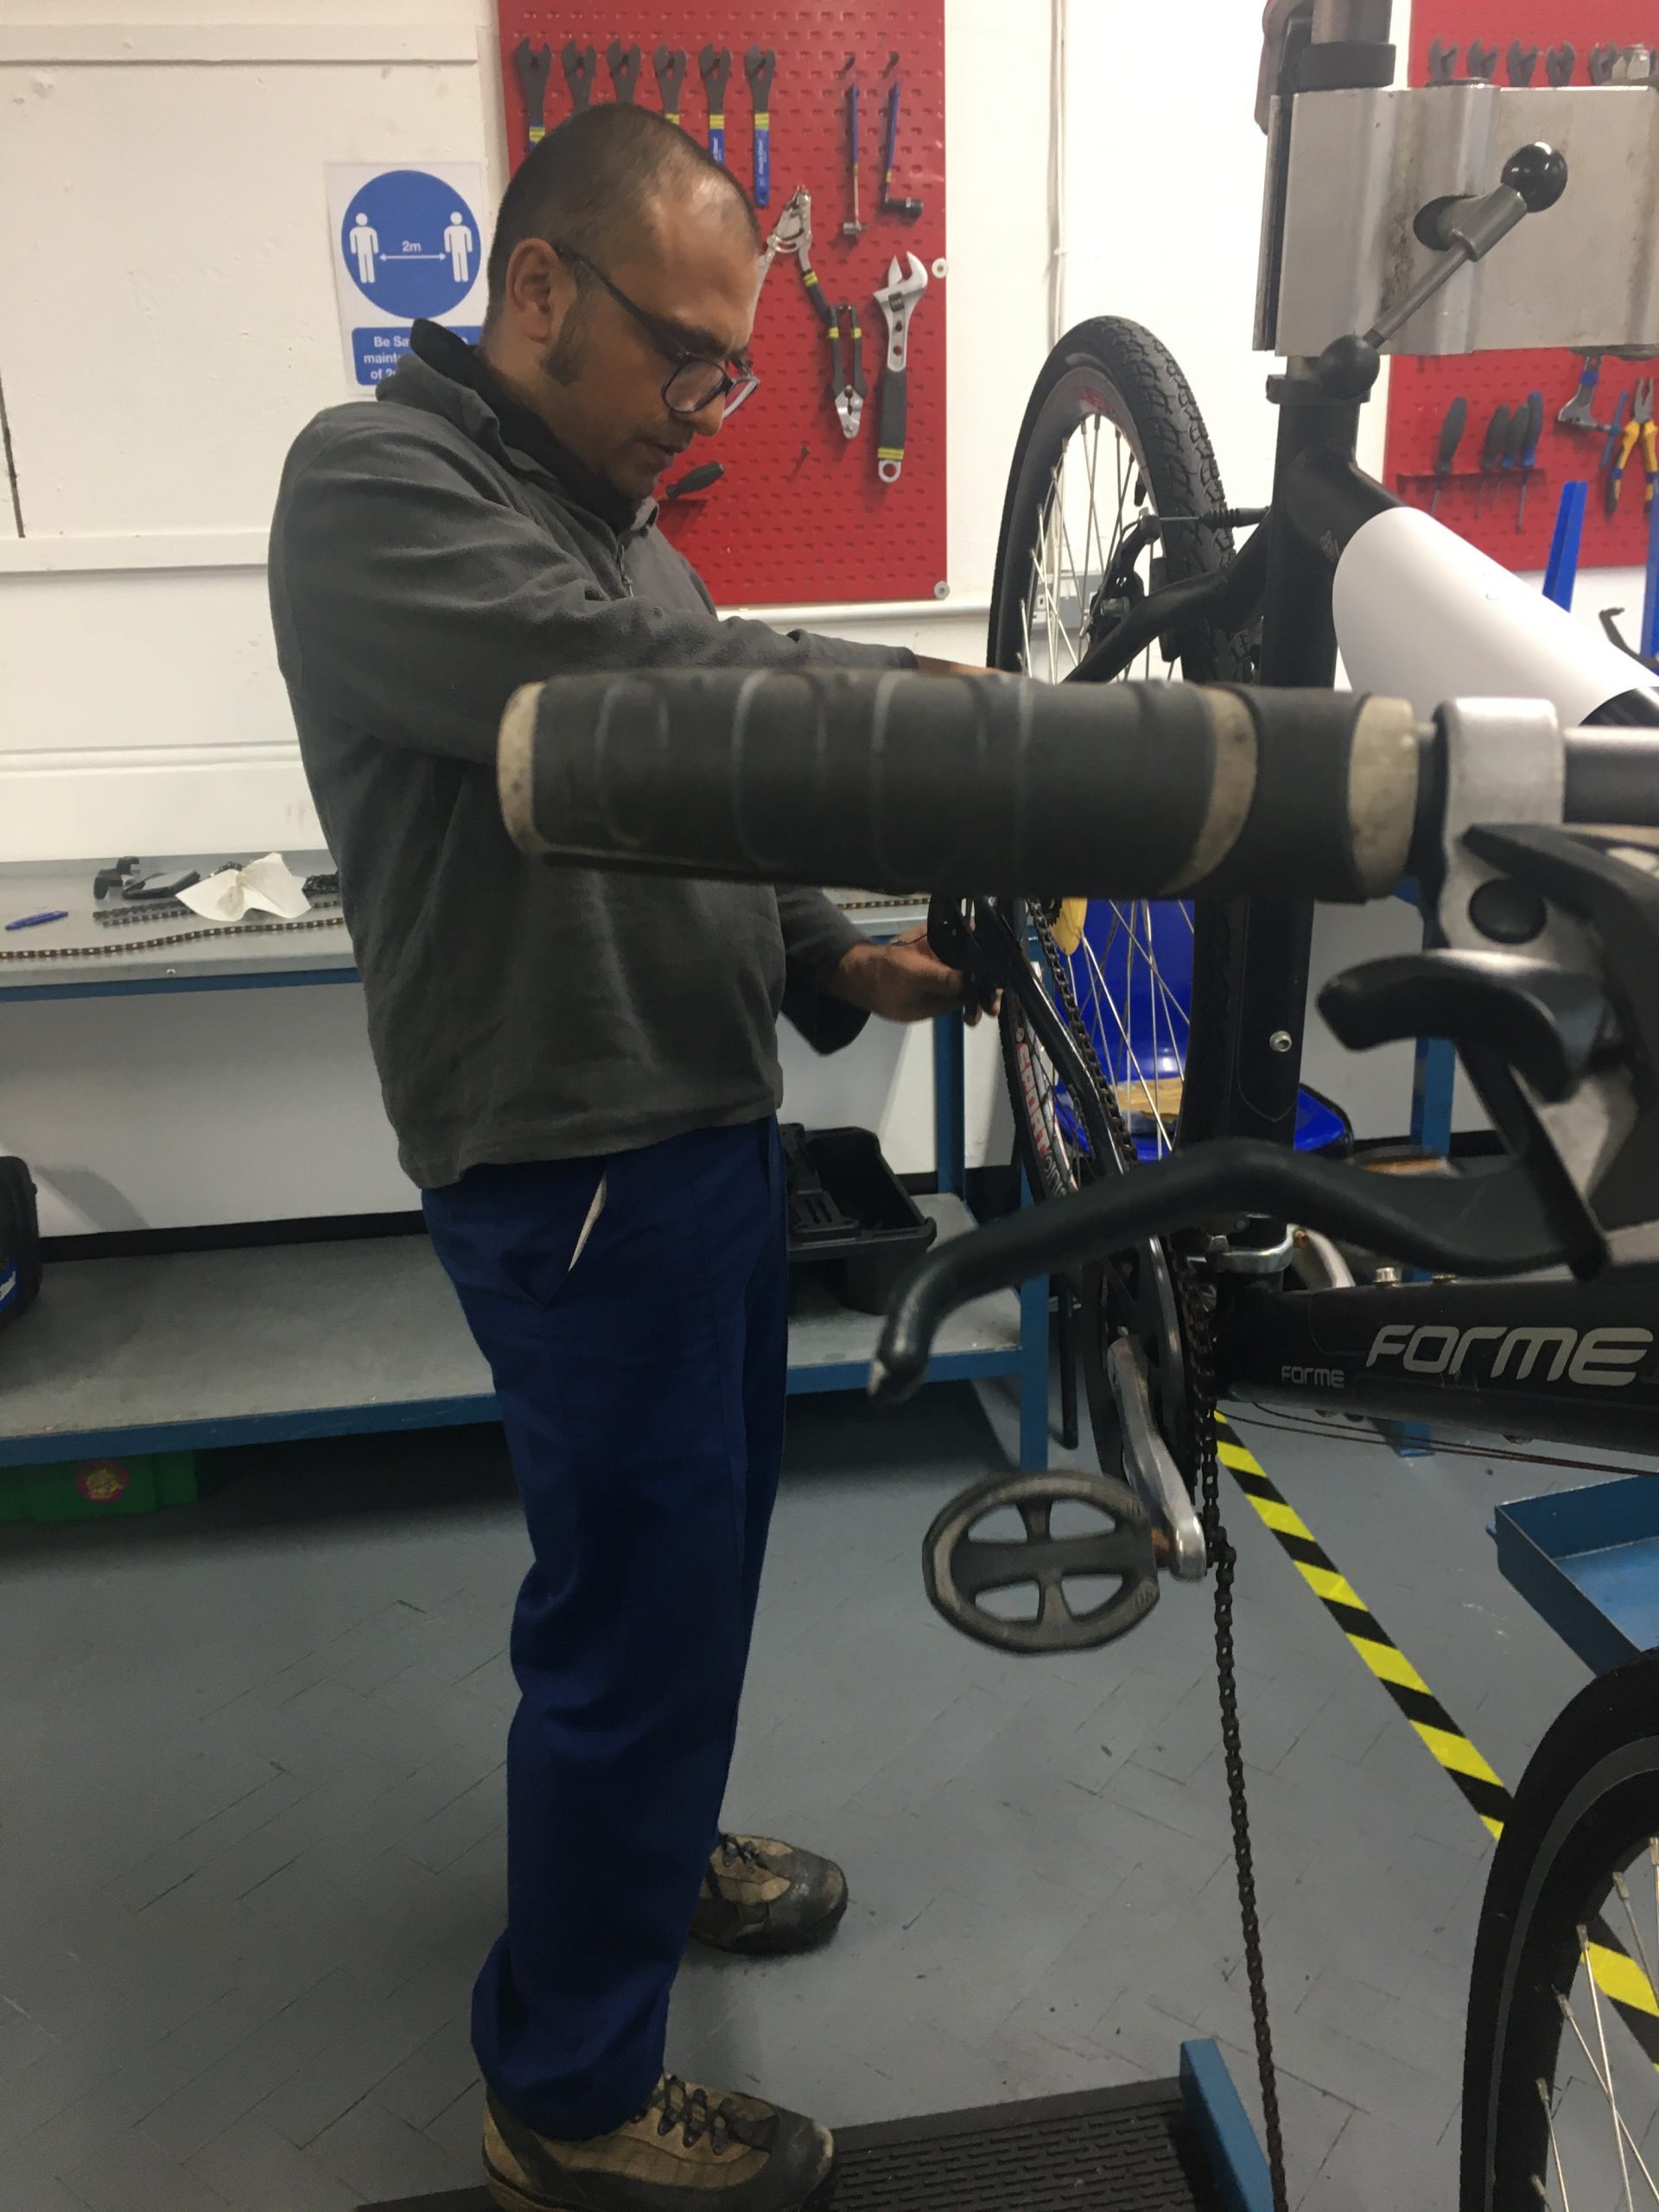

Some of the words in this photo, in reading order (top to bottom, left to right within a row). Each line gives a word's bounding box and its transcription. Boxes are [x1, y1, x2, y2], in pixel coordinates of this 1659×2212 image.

[402, 239, 422, 252] 2m
[373, 335, 391, 347] Be
[393, 335, 410, 347] Sa
[364, 353, 398, 364] maint
[370, 368, 382, 380] of
[1365, 1325, 1654, 1386] FORME
[1281, 1365, 1345, 1389] FORME
